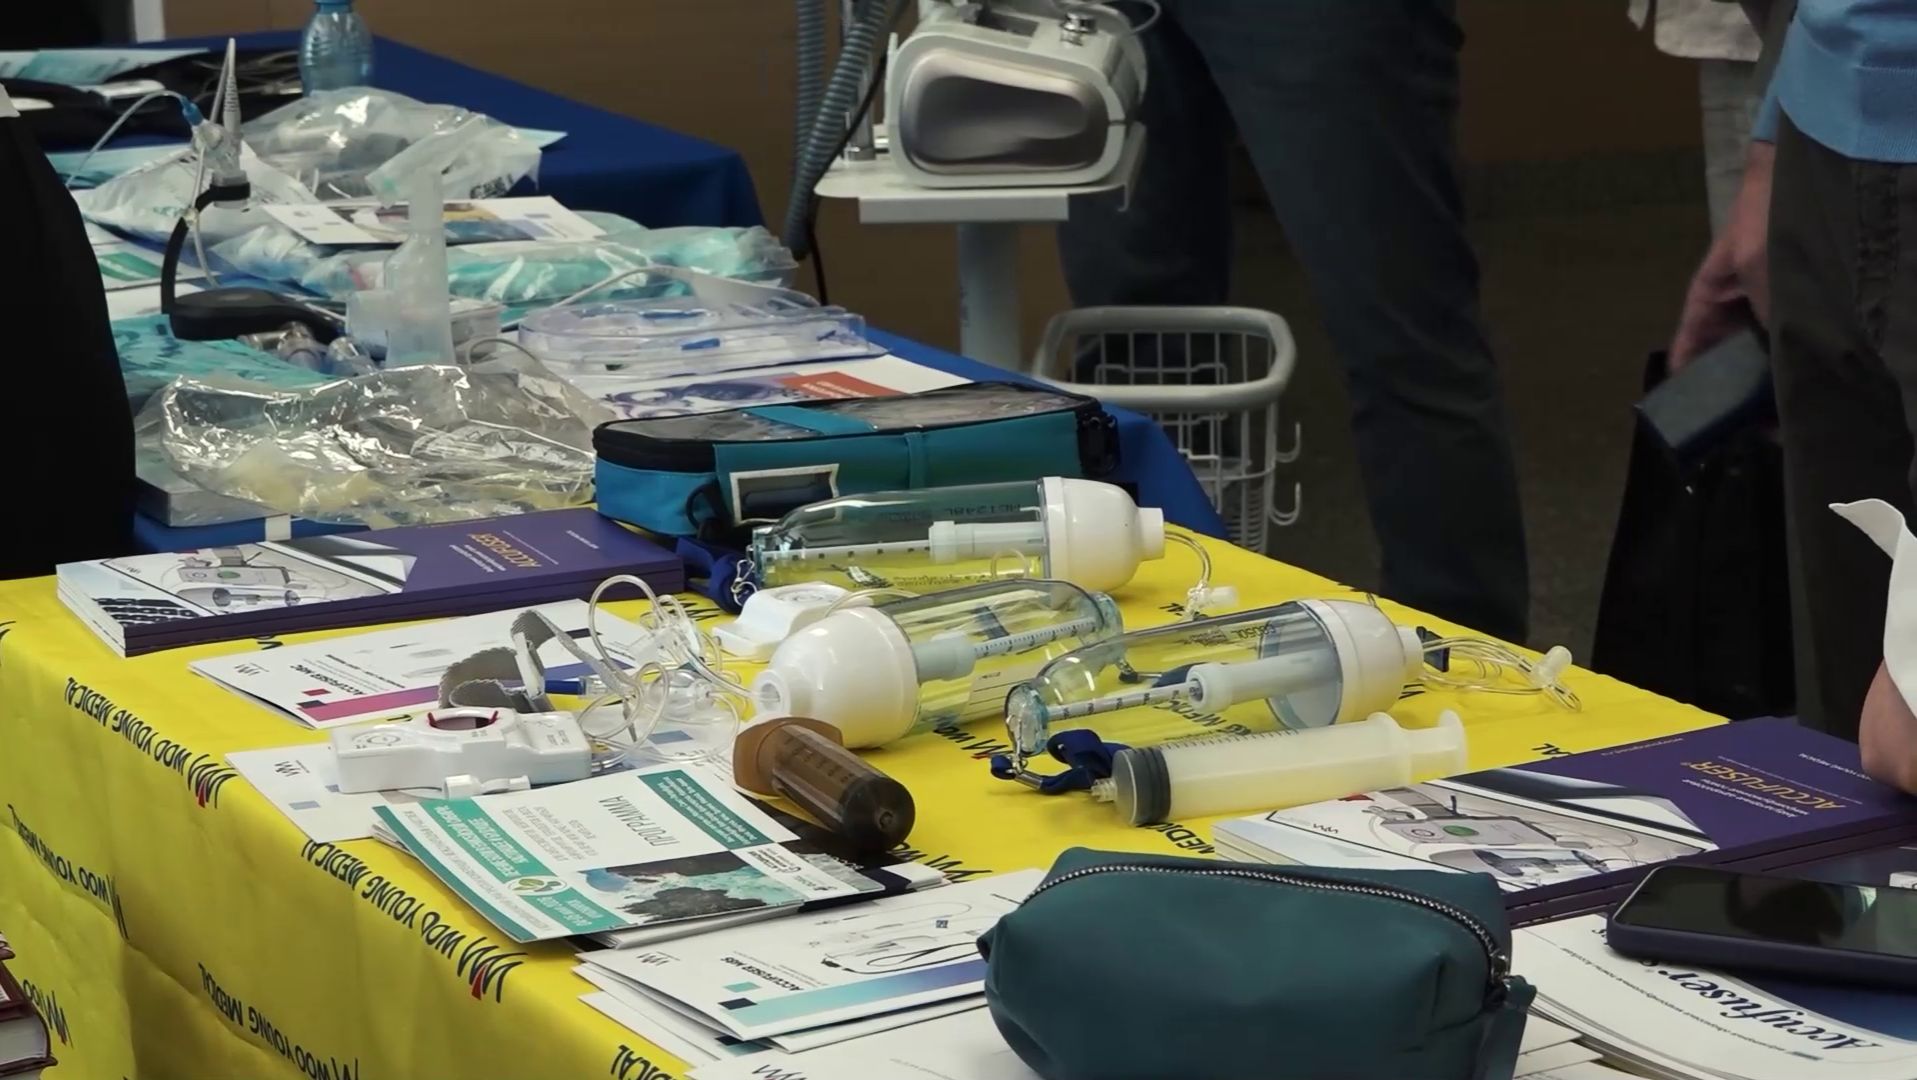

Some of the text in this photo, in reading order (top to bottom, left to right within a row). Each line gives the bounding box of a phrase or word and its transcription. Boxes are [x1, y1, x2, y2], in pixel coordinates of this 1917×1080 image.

[63, 676, 186, 776] WOO YOUNG MEDICAL
[1690, 761, 1848, 809] ACCUFUSER
[598, 795, 679, 847] ПРОГРАММА
[79, 867, 111, 906] WOO
[301, 840, 372, 892] MEDICAL
[361, 875, 425, 930] YOUNG
[421, 911, 468, 960] WOO
[1658, 971, 1884, 1051] Accufuser
